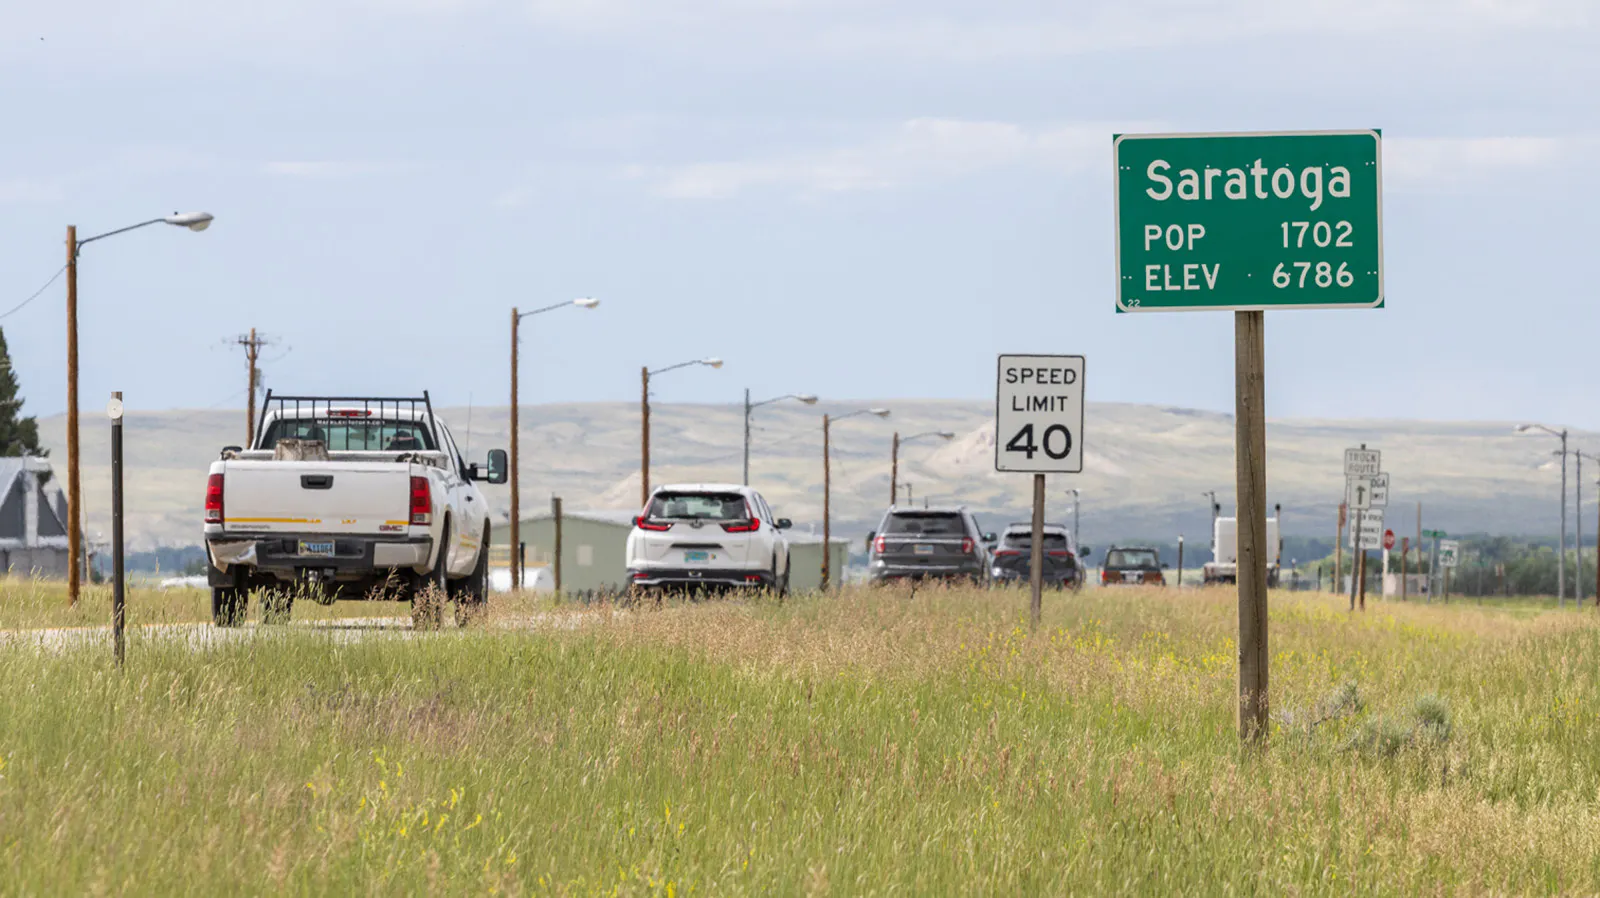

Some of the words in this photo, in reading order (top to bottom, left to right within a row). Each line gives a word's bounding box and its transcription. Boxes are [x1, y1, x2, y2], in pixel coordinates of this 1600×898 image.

[1146, 159, 1350, 211] Saratoga
[1145, 224, 1205, 250] POP
[1282, 221, 1352, 247] 1702
[1146, 264, 1219, 290] ELEV
[1273, 262, 1353, 288] 6786
[1127, 299, 1141, 308] 22
[1006, 368, 1076, 384] SPEED
[1013, 396, 1068, 411] LIMIT
[1006, 424, 1072, 460] 40
[1349, 452, 1376, 462] TRUCK
[1348, 463, 1375, 473] ROUTE
